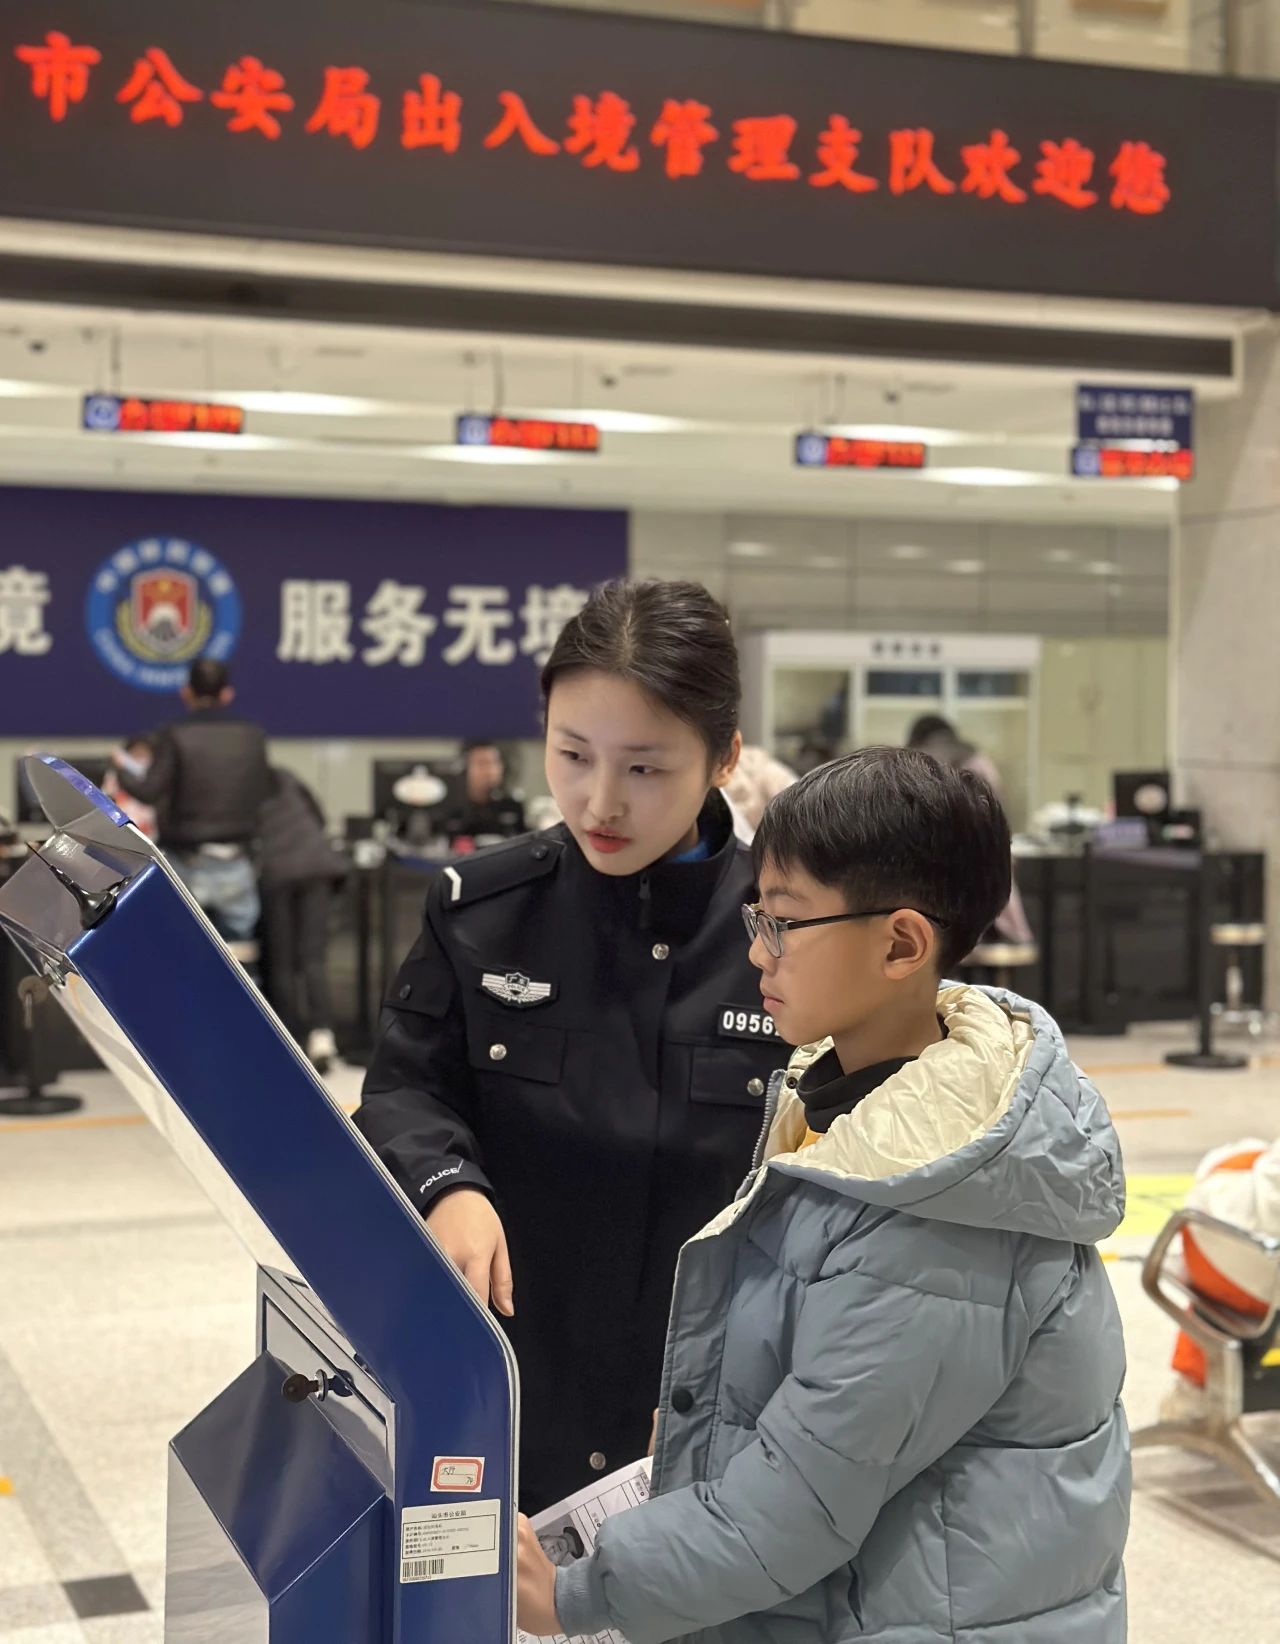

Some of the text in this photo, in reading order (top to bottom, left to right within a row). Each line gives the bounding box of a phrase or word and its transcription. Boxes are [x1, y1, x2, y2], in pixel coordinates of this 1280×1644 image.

[15, 31, 1171, 215] 市公安局出入境管理支队欢迎您
[722, 1010, 781, 1037] 0956
[419, 1167, 460, 1194] POLICE
